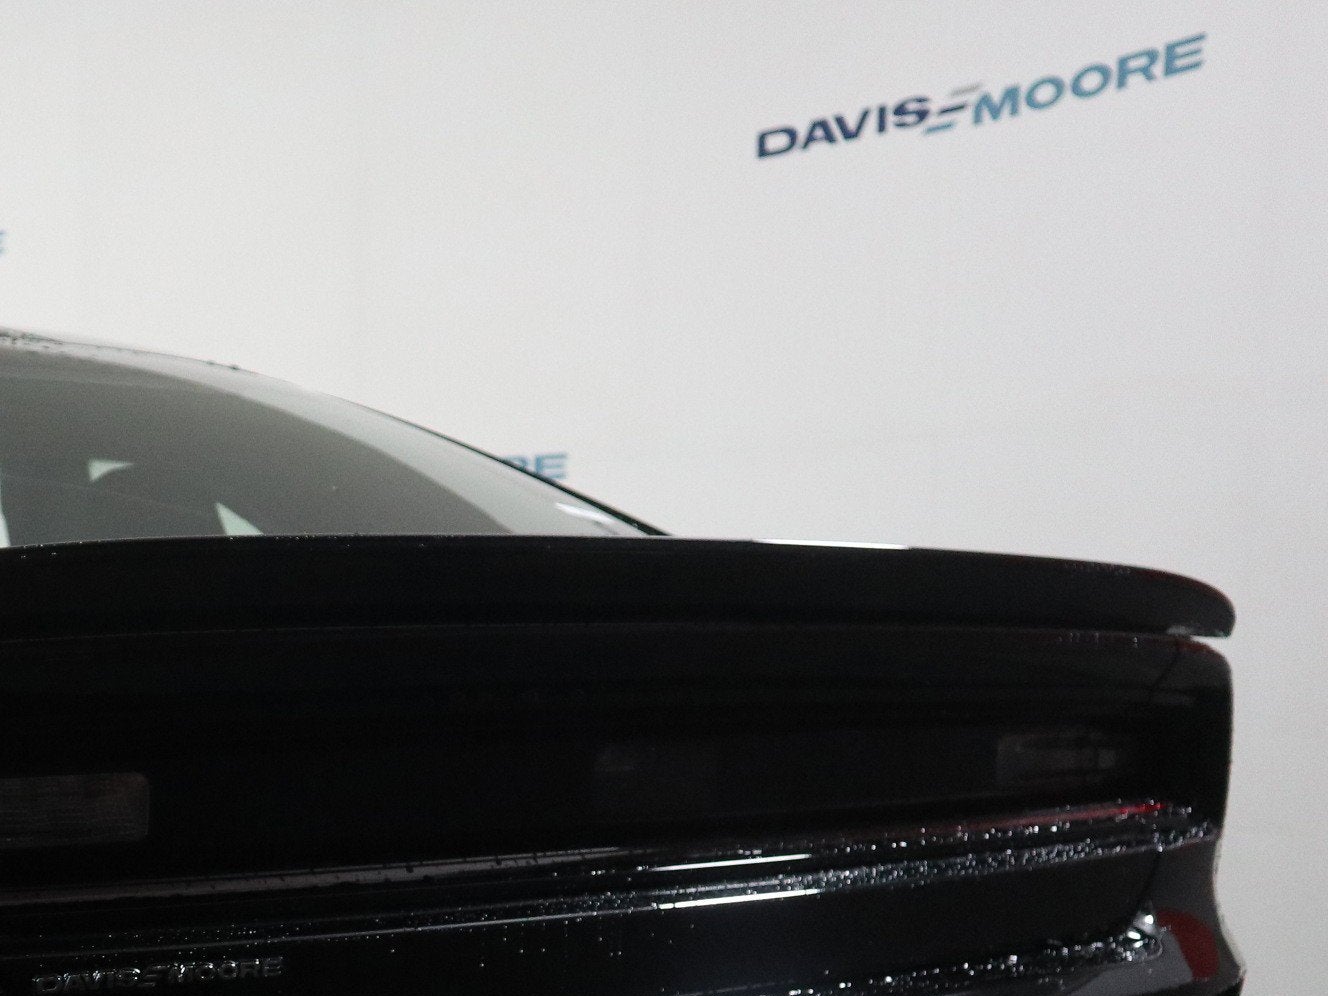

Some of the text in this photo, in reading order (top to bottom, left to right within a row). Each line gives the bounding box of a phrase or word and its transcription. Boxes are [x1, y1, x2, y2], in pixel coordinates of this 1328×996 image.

[756, 33, 1207, 159] DAVIS MOORE
[32, 956, 284, 992] DAVIS MOORE
